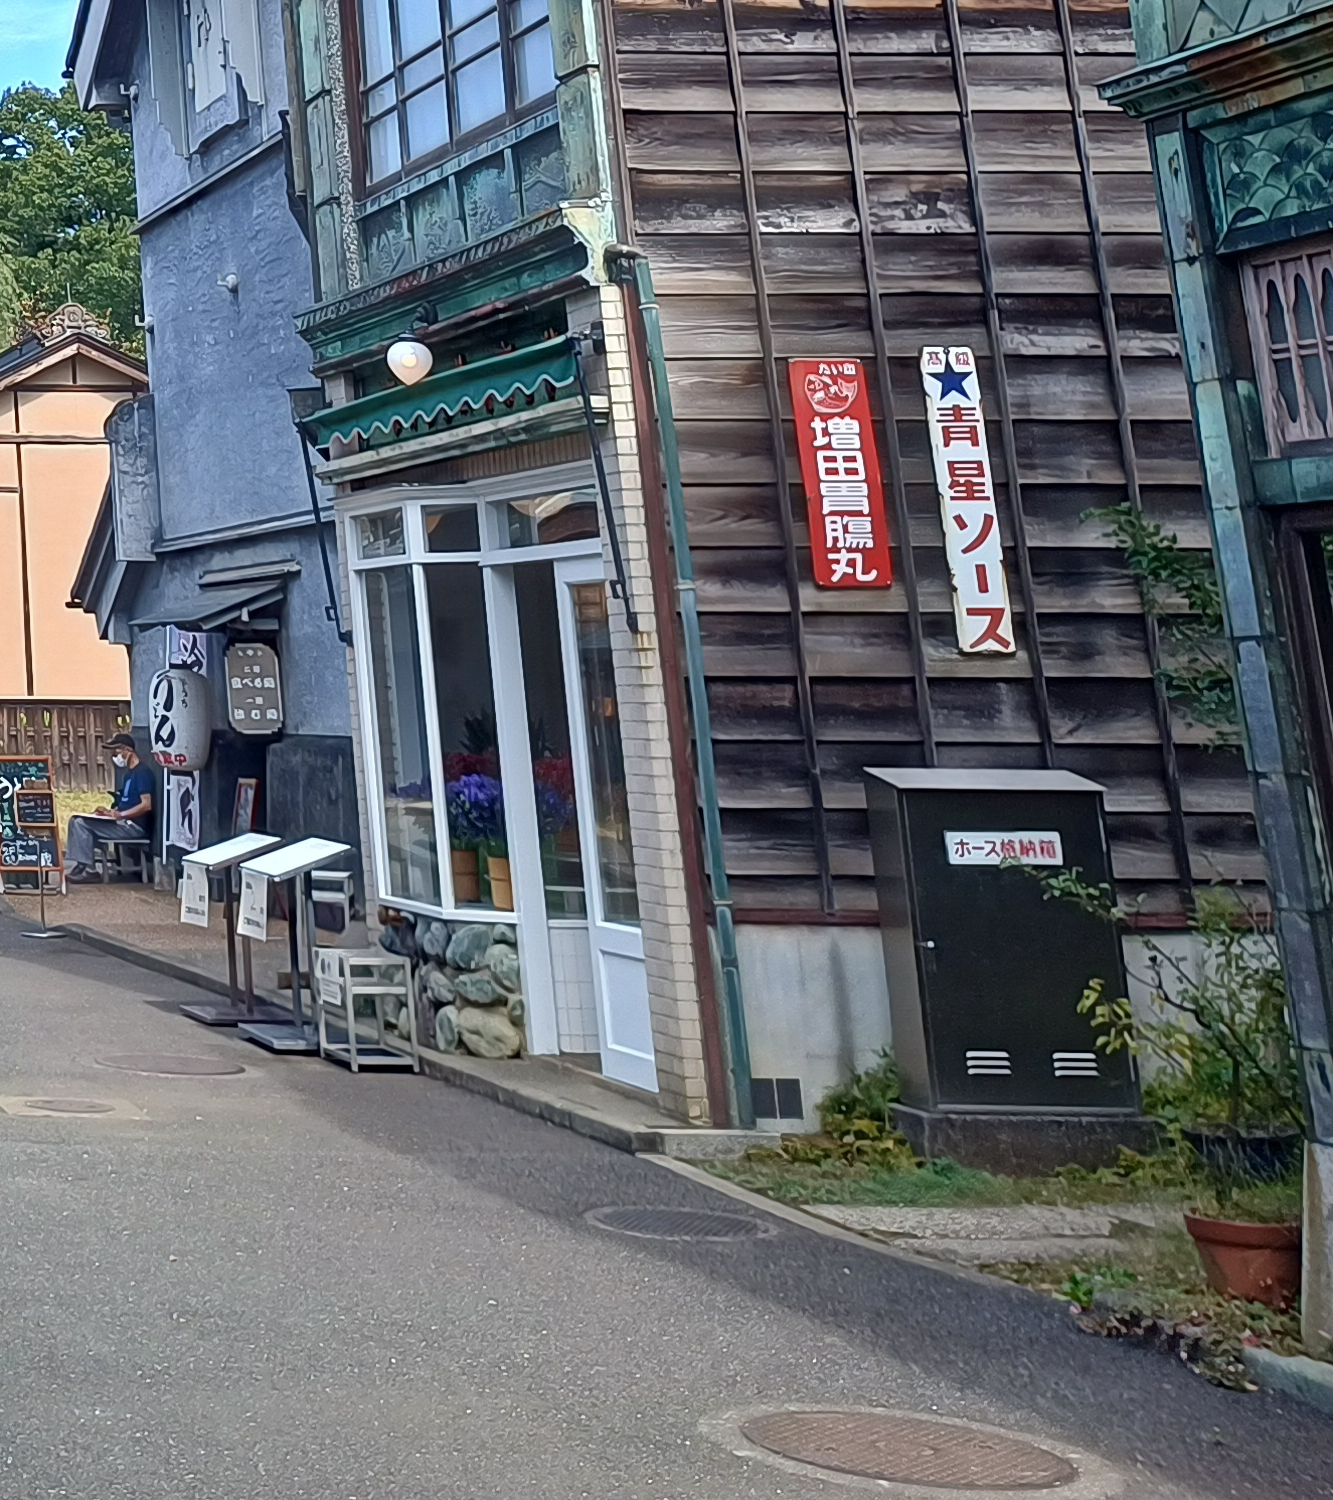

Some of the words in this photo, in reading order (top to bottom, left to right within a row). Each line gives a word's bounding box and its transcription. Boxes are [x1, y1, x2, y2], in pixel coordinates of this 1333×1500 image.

[936, 404, 1011, 650] 青星ソース
